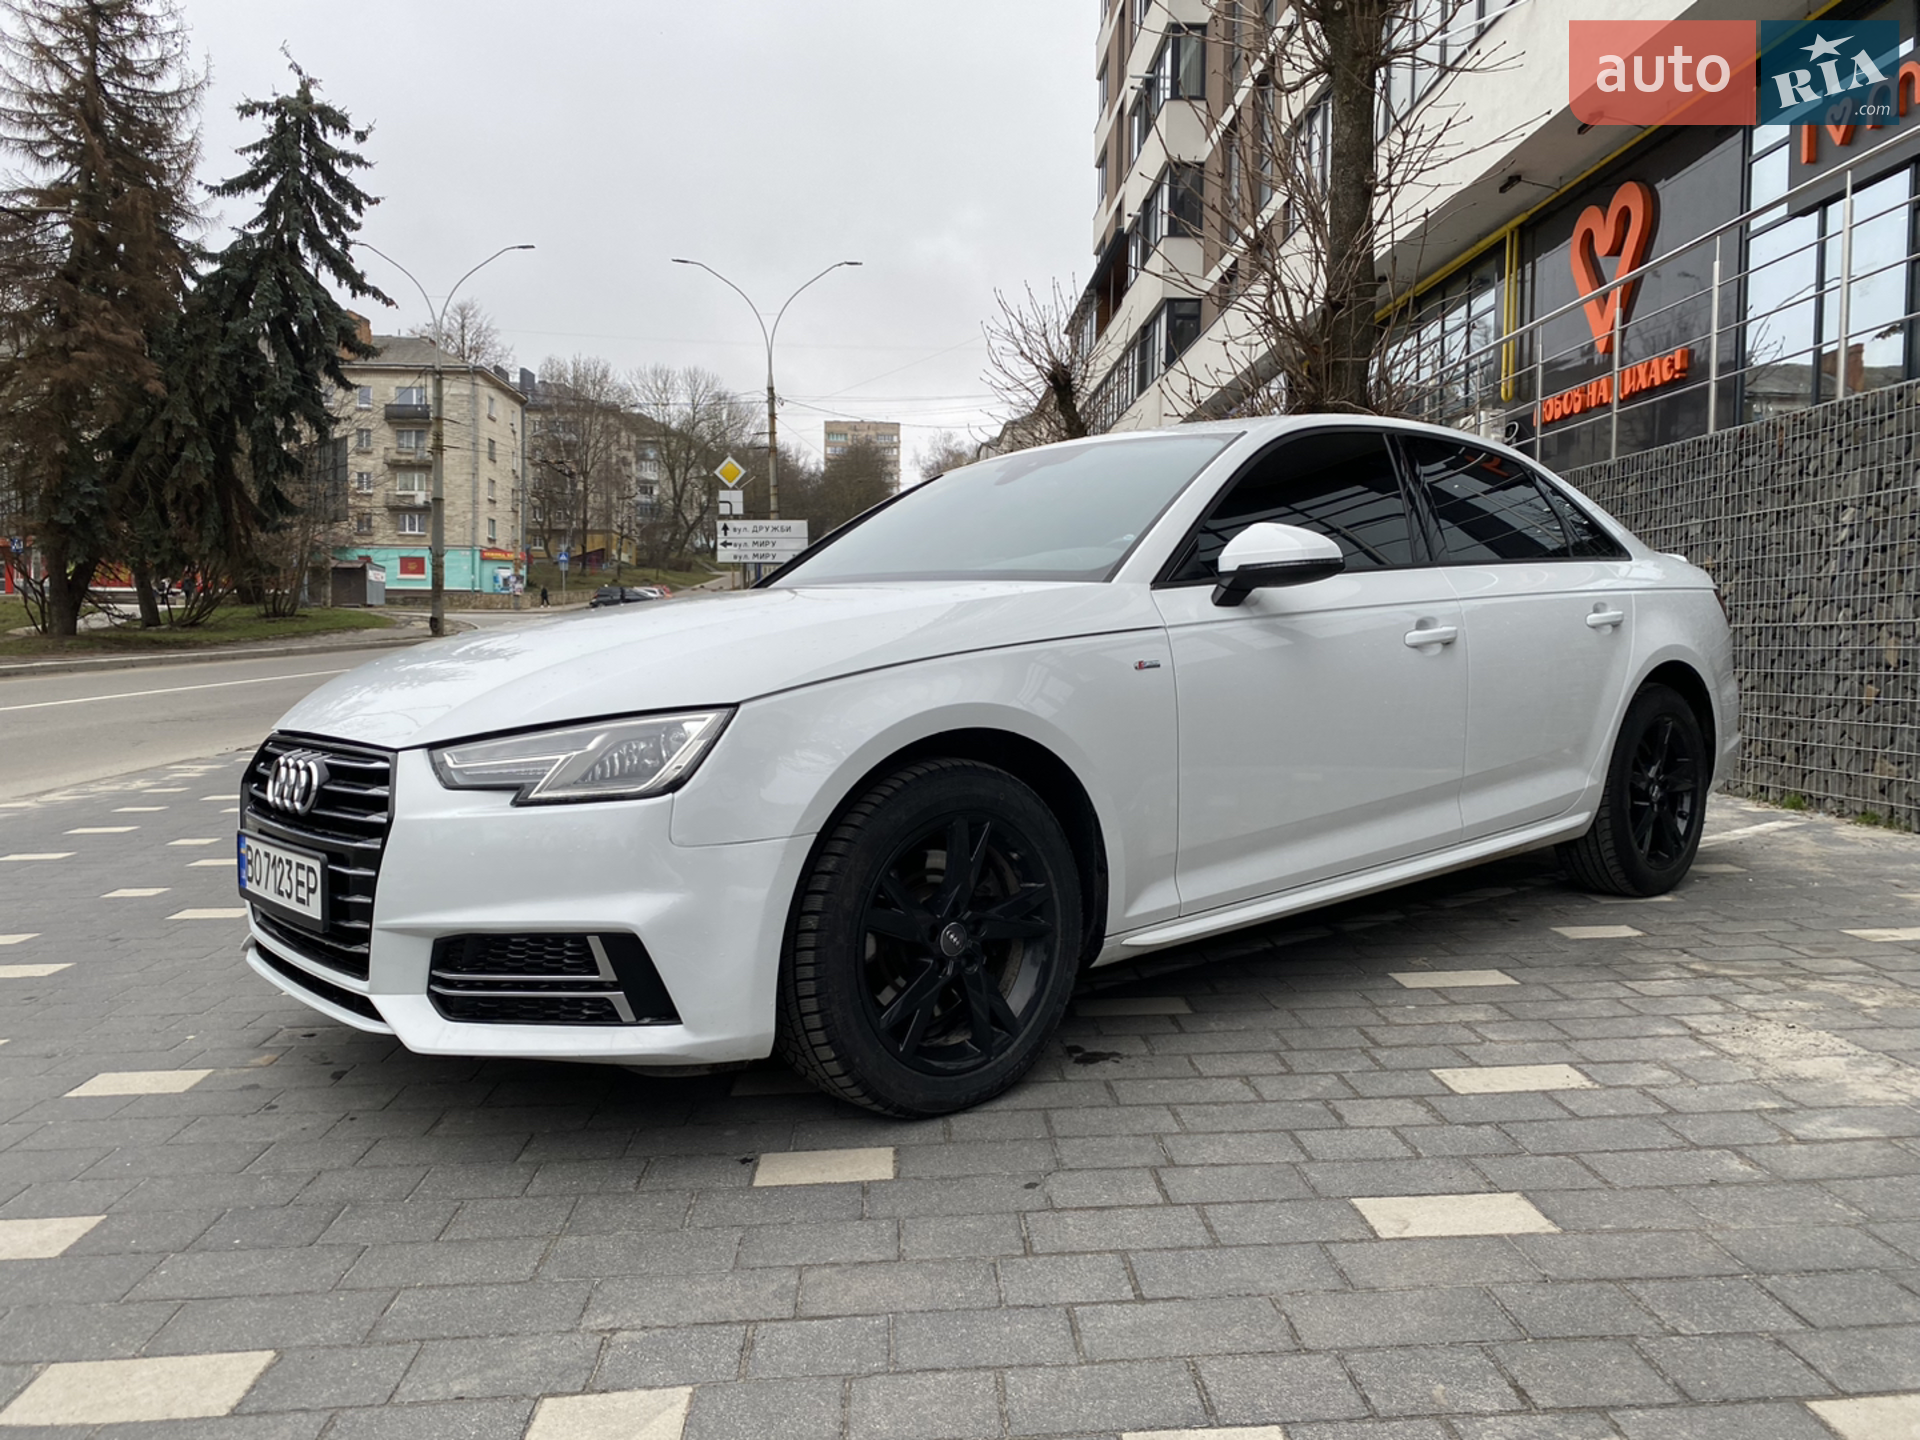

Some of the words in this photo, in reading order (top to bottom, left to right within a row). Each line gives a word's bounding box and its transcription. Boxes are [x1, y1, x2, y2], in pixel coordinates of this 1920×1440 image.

[733, 526, 749, 535] вул.
[752, 525, 792, 533] ДРУЖБИ
[733, 541, 749, 549] вул.
[752, 540, 777, 548] МИРУ
[733, 553, 749, 561] вул.
[752, 552, 777, 560] МИРУ
